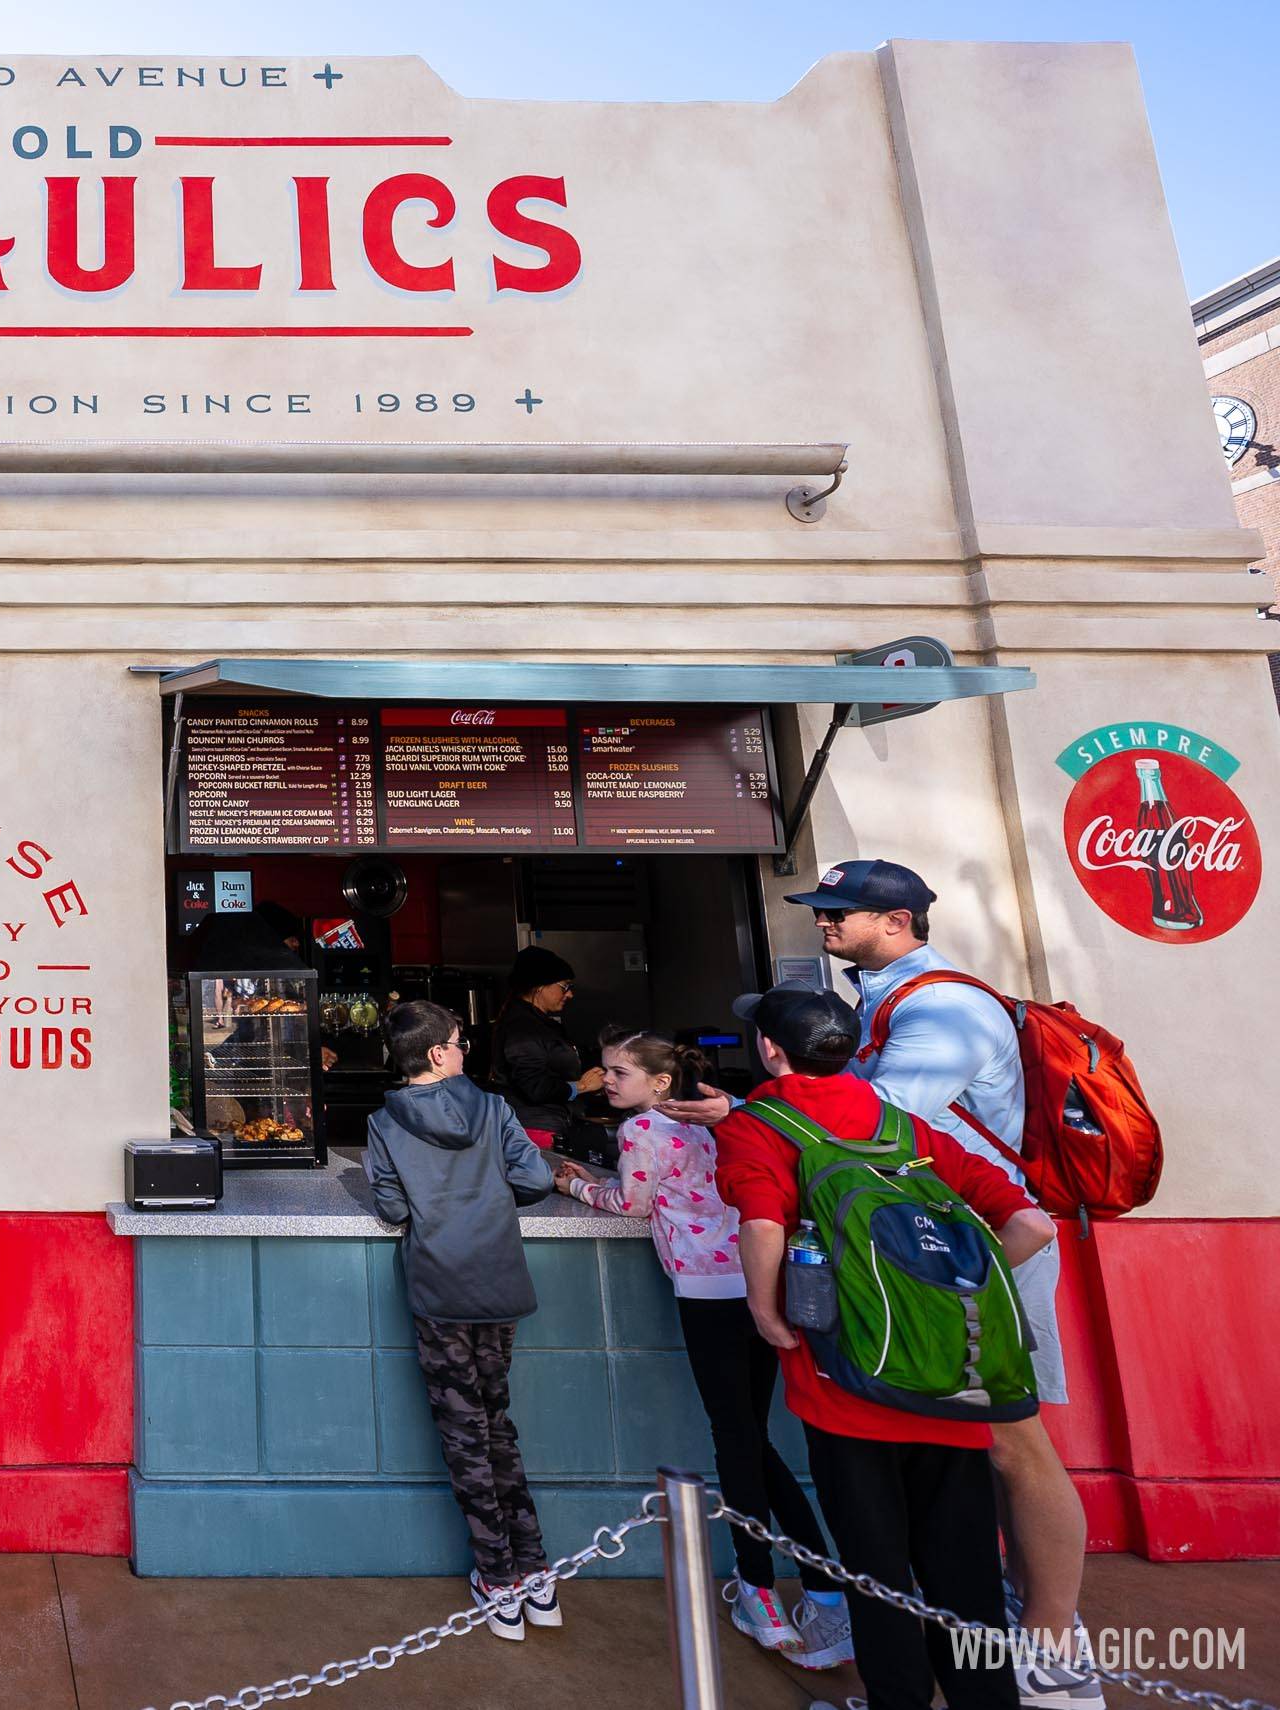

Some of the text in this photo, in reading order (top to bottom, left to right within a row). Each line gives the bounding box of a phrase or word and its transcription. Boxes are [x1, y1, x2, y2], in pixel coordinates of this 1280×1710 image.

[56, 67, 289, 88] AVENUE
[143, 394, 312, 414] SINCE
[354, 392, 477, 414] 1989
[1077, 727, 1212, 764] SIEMPRE
[555, 800, 572, 808] 9.50
[1077, 815, 1246, 872] Coca-Cola
[222, 881, 245, 891] Rum
[192, 891, 200, 899] &
[184, 900, 209, 909] Coke
[221, 899, 246, 909] Coke
